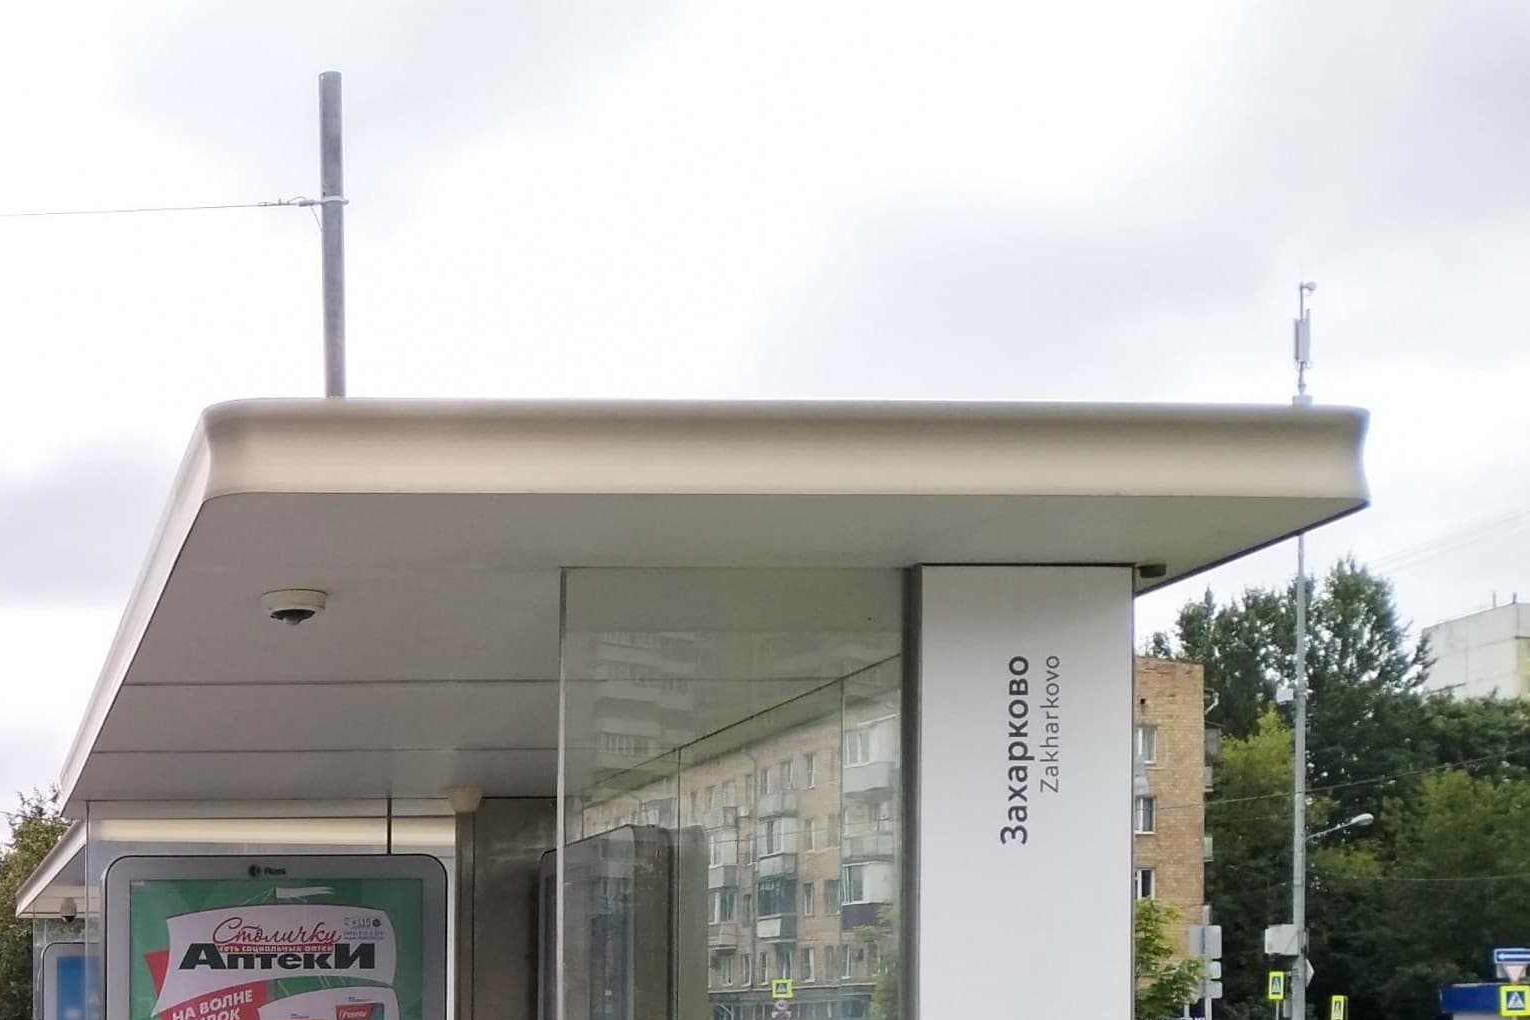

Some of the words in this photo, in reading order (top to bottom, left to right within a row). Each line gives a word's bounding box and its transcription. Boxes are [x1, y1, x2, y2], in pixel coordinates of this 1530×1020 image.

[1000, 655, 1035, 845] Захарково
[1039, 655, 1060, 793] Zakharkovo
[198, 989, 254, 1015] ВОЛНЕ
